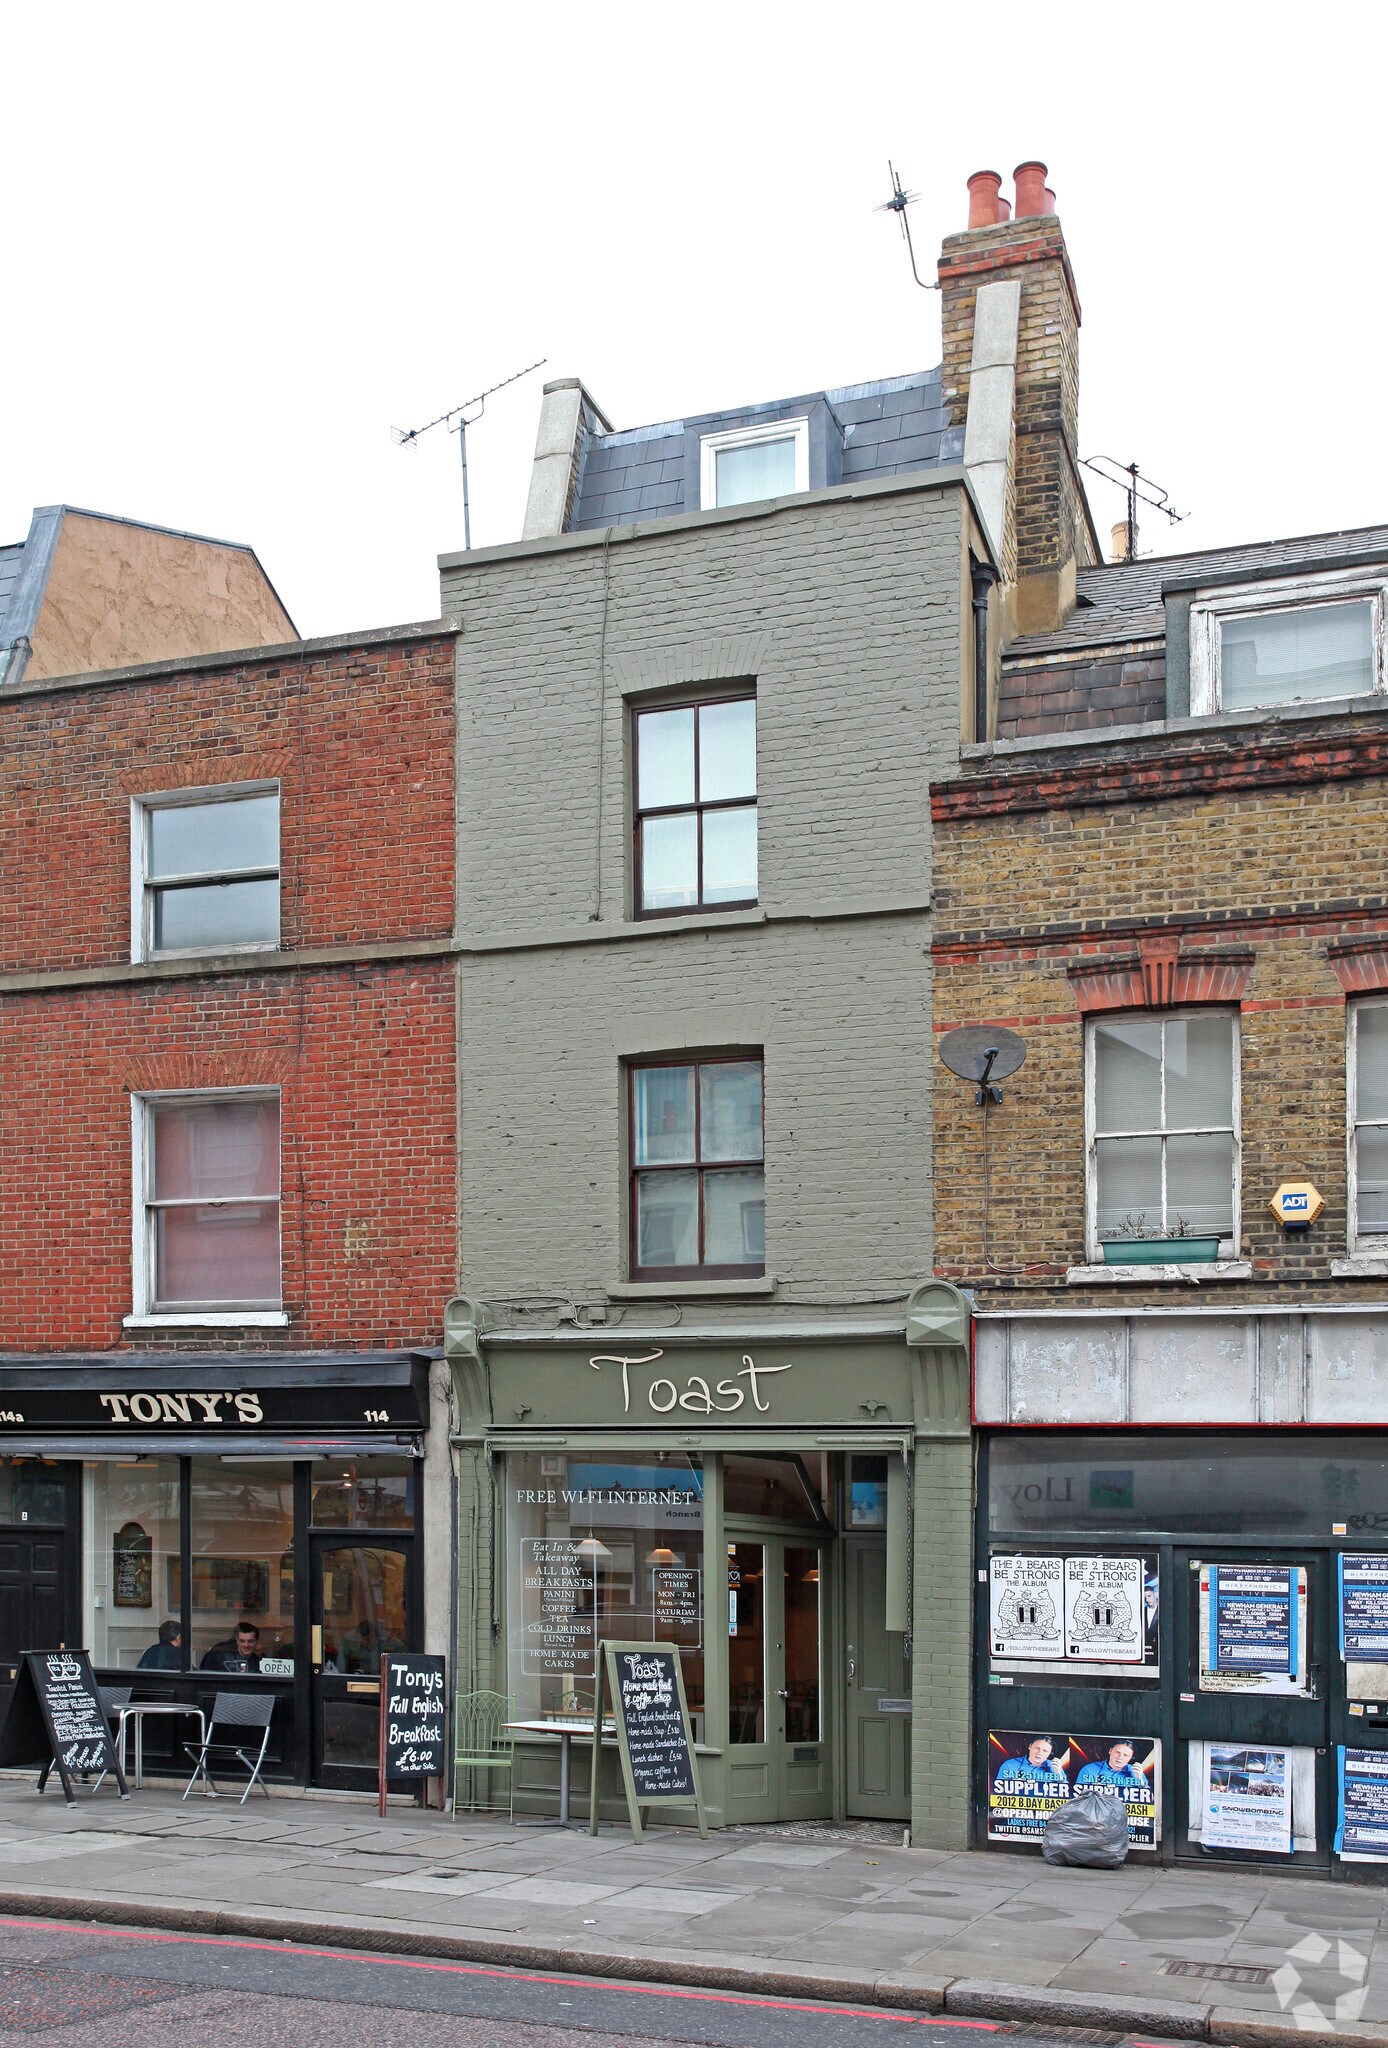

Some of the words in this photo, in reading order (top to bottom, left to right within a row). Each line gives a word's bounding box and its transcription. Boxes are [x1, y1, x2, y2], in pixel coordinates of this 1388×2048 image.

[1283, 1197, 1308, 1207] ADT
[589, 1347, 792, 1414] Toast
[100, 1392, 264, 1423] TONY'S
[364, 1410, 389, 1422] 114
[516, 1490, 557, 1503] FREE
[561, 1490, 604, 1504] WI-FI
[608, 1490, 694, 1505] INTERNET
[533, 1542, 549, 1551] Eat
[552, 1542, 563, 1551] In
[567, 1542, 577, 1552] &
[534, 1552, 580, 1565] Takeaway
[992, 1560, 1013, 1569] THE
[1016, 1561, 1022, 1569] 2
[1027, 1561, 1061, 1570] BEARS
[1068, 1561, 1088, 1571] THE
[1092, 1562, 1098, 1571] 2
[1103, 1562, 1137, 1571] BEARS
[536, 1566, 557, 1575] ALL
[560, 1567, 582, 1576] DAY
[659, 1572, 693, 1580] OPENING
[994, 1570, 1008, 1579] BE
[1014, 1571, 1060, 1580] STRONG
[1069, 1571, 1083, 1581] BE
[1089, 1572, 1137, 1582] STRONG
[525, 1578, 593, 1587] BREAKFASTS
[544, 1590, 575, 1598] PANINI
[542, 1604, 577, 1613] COFFEE
[657, 1608, 696, 1616] SATURDAY
[550, 1615, 569, 1623] TEA
[528, 1624, 553, 1632] COLD
[557, 1625, 592, 1633] DRINKS
[544, 1635, 576, 1643] LUNCH
[530, 1650, 557, 1658] HOME
[562, 1651, 590, 1659] MADE
[264, 1663, 291, 1674] OPEN
[545, 1660, 575, 1668] CAKES
[624, 1654, 665, 1680] Toast
[391, 1664, 443, 1695] Tony's
[46, 1684, 68, 1692] Toasted
[632, 1692, 652, 1710] coffee
[654, 1692, 672, 1707] shop
[389, 1695, 409, 1714] Full
[412, 1696, 444, 1721] English
[627, 1713, 637, 1723] Full
[389, 1724, 442, 1745] Breakfast
[654, 1726, 665, 1738] Soup
[396, 1747, 433, 1766] £6.00
[632, 1754, 647, 1763] Lunch
[1003, 1771, 1019, 1779] SAT
[1021, 1771, 1044, 1780] 25TH
[1045, 1772, 1060, 1781] FEB
[1082, 1775, 1099, 1783] SAT
[1100, 1775, 1124, 1785] 25TH
[1125, 1776, 1140, 1786] FEB
[994, 1780, 1070, 1798] SUPPLIER
[1353, 1784, 1382, 1792] NEWHAM
[997, 1796, 1017, 1808] 2012
[1018, 1797, 1044, 1809] B.DAY
[993, 1808, 1034, 1819] @OPERA
[1222, 1806, 1285, 1816] SNOWBOMBING
[1007, 1818, 1026, 1827] LADIES
[1026, 1819, 1039, 1827] FREE
[995, 1825, 1021, 1834] TWITTER
